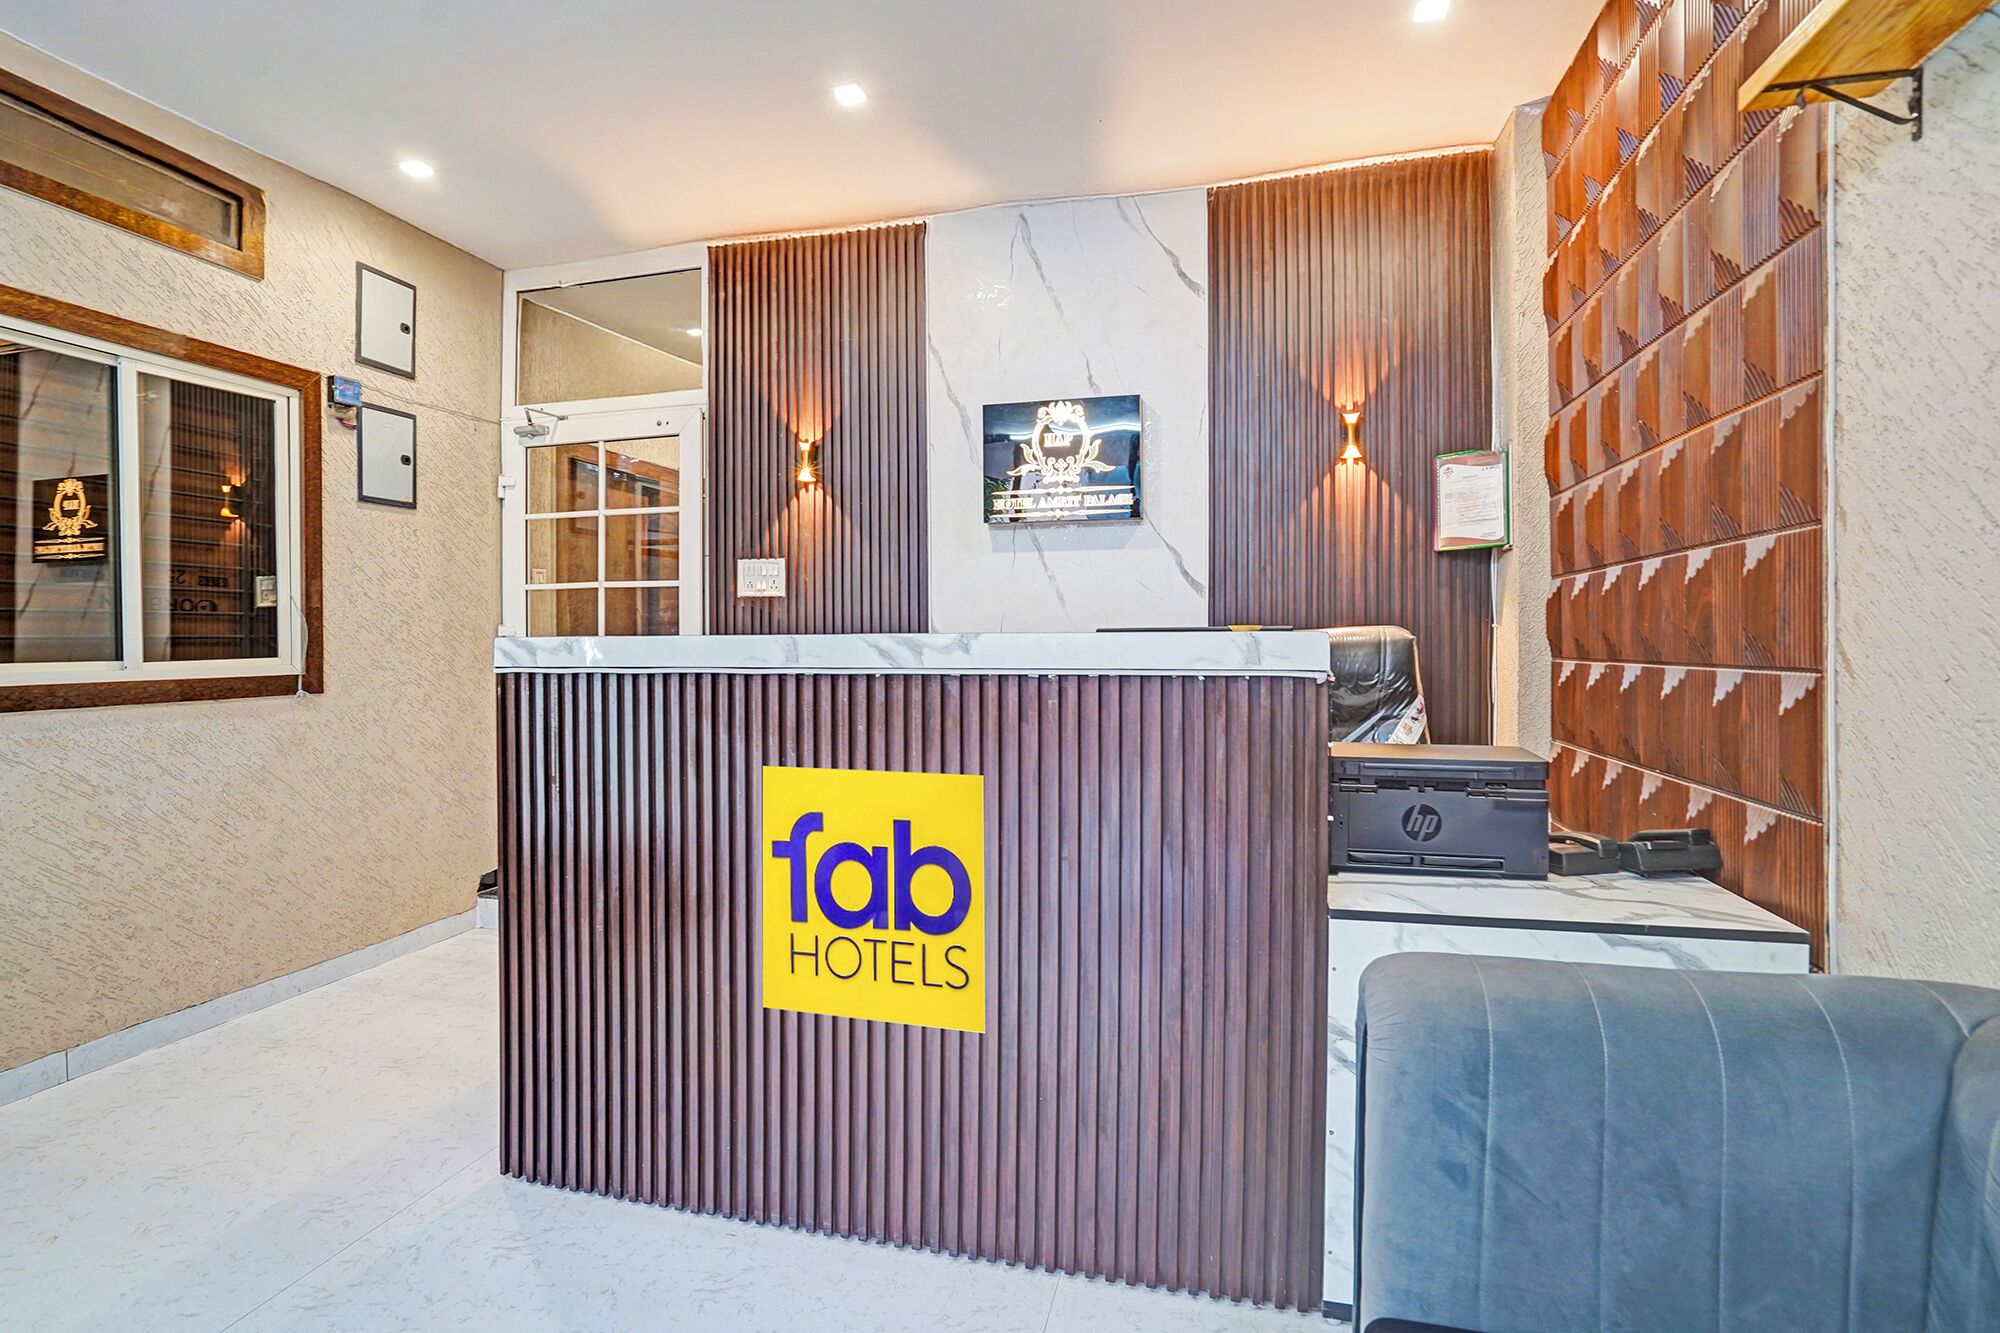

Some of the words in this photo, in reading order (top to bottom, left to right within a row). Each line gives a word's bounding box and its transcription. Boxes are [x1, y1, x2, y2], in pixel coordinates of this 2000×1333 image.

[993, 497, 1037, 510] HOTEL
[1083, 493, 1134, 507] PALACE
[1405, 803, 1439, 842] hp
[772, 811, 972, 936] fab
[790, 932, 970, 990] HOTELS
